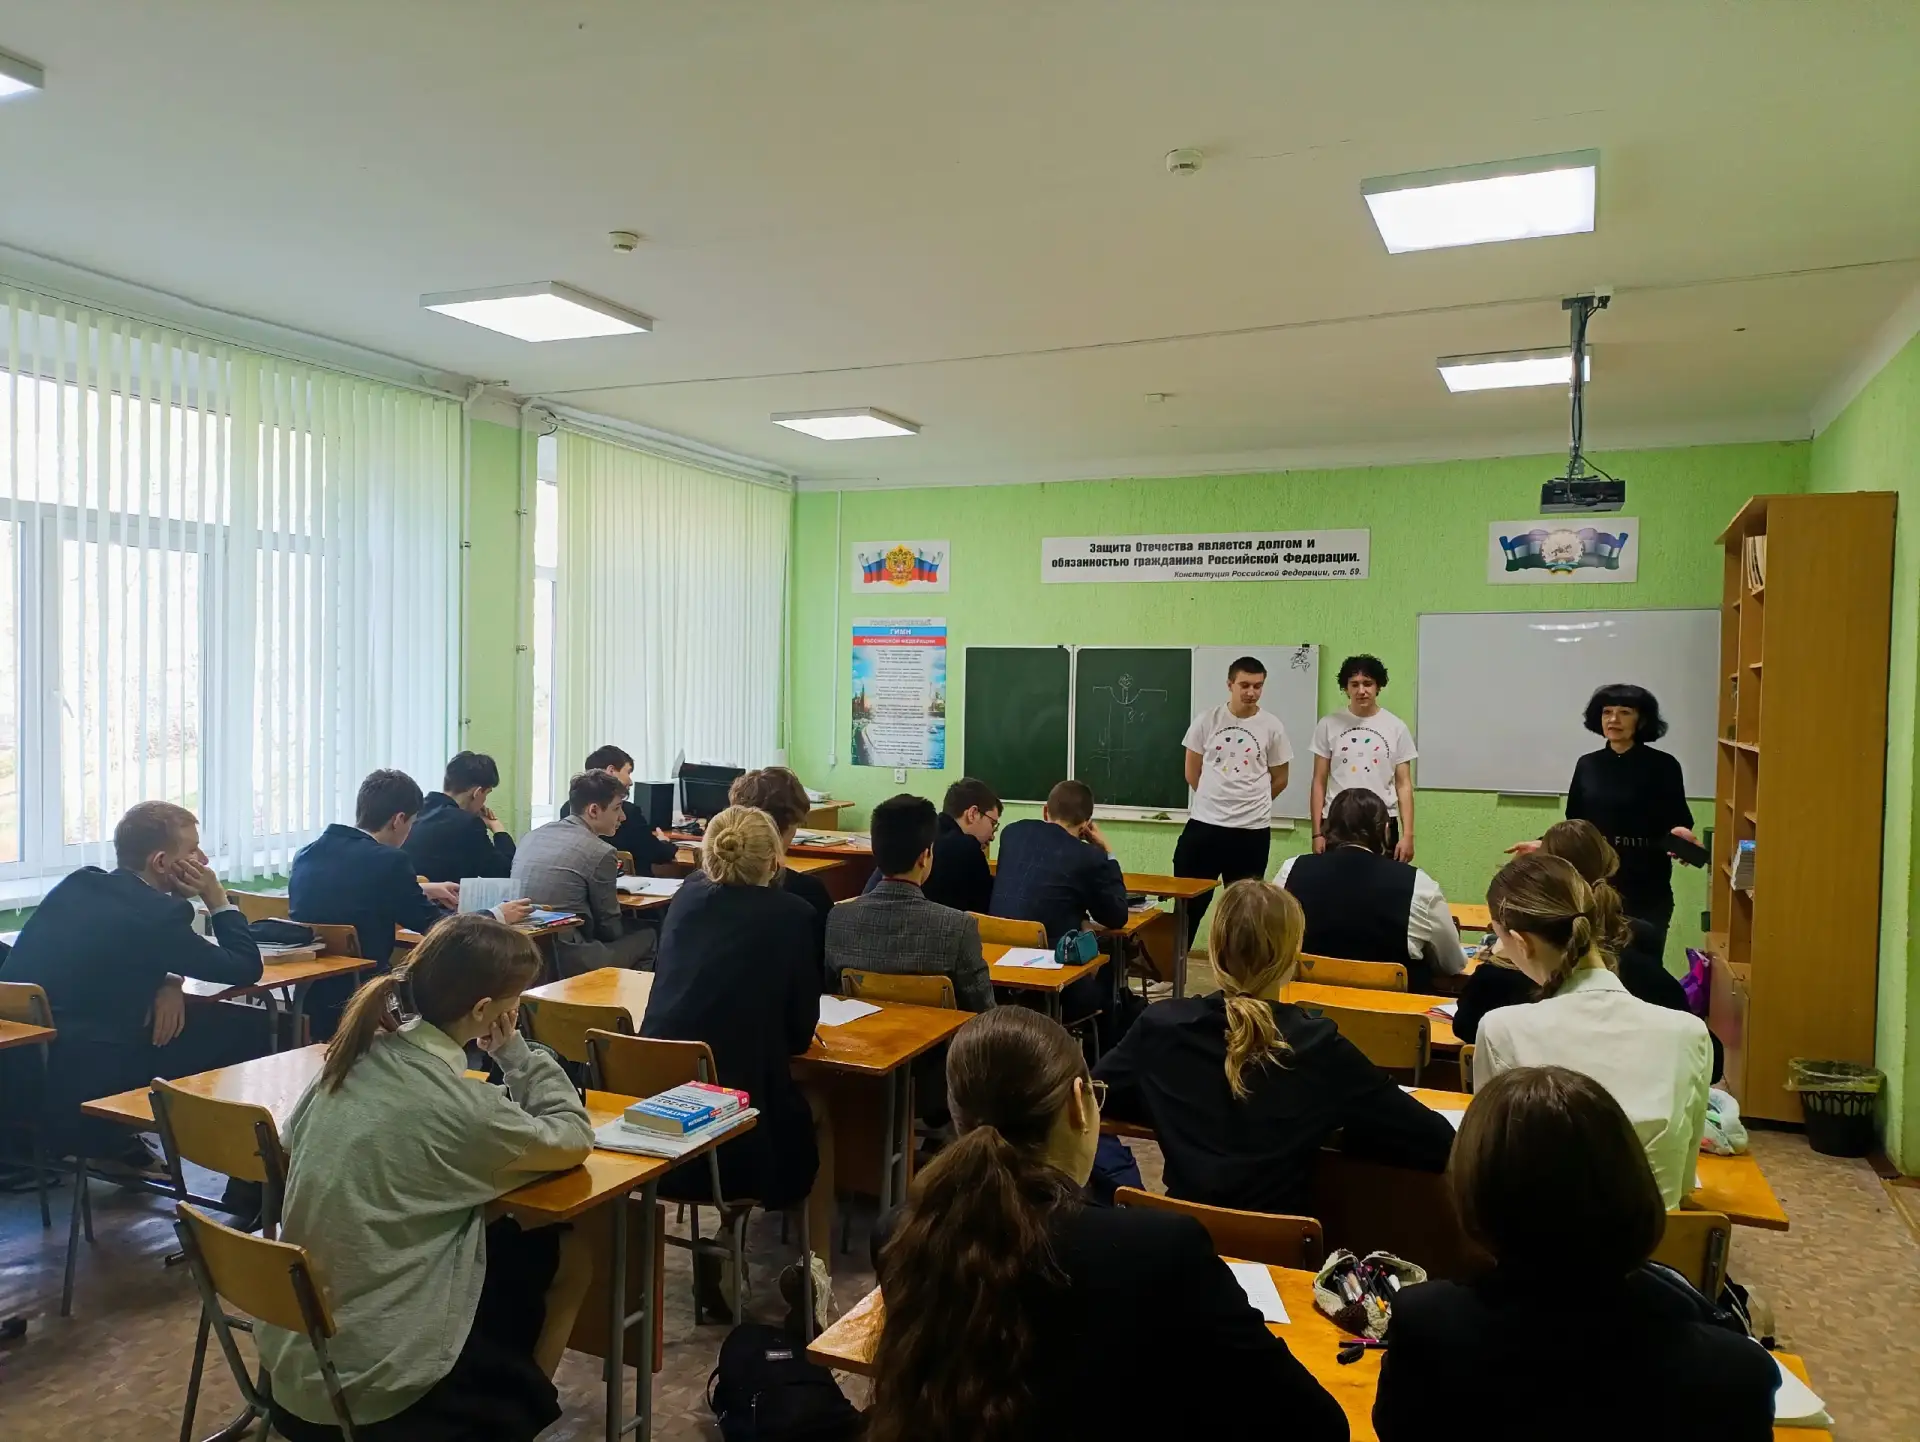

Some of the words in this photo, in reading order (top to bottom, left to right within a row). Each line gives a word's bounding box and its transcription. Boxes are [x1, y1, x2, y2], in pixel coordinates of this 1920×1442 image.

[1089, 543, 1131, 553] Защита
[1136, 541, 1193, 552] Отечества
[1198, 541, 1252, 551] является
[1256, 539, 1302, 550] долгом
[1307, 538, 1315, 548] и
[1052, 557, 1129, 568] обязанностью
[1133, 555, 1203, 567] гражданина
[1208, 553, 1279, 565] Российской
[1283, 552, 1360, 564] Федерации.
[1174, 570, 1229, 579] Конституция
[1231, 569, 1279, 577] Российской
[1281, 568, 1330, 578] Федерации,
